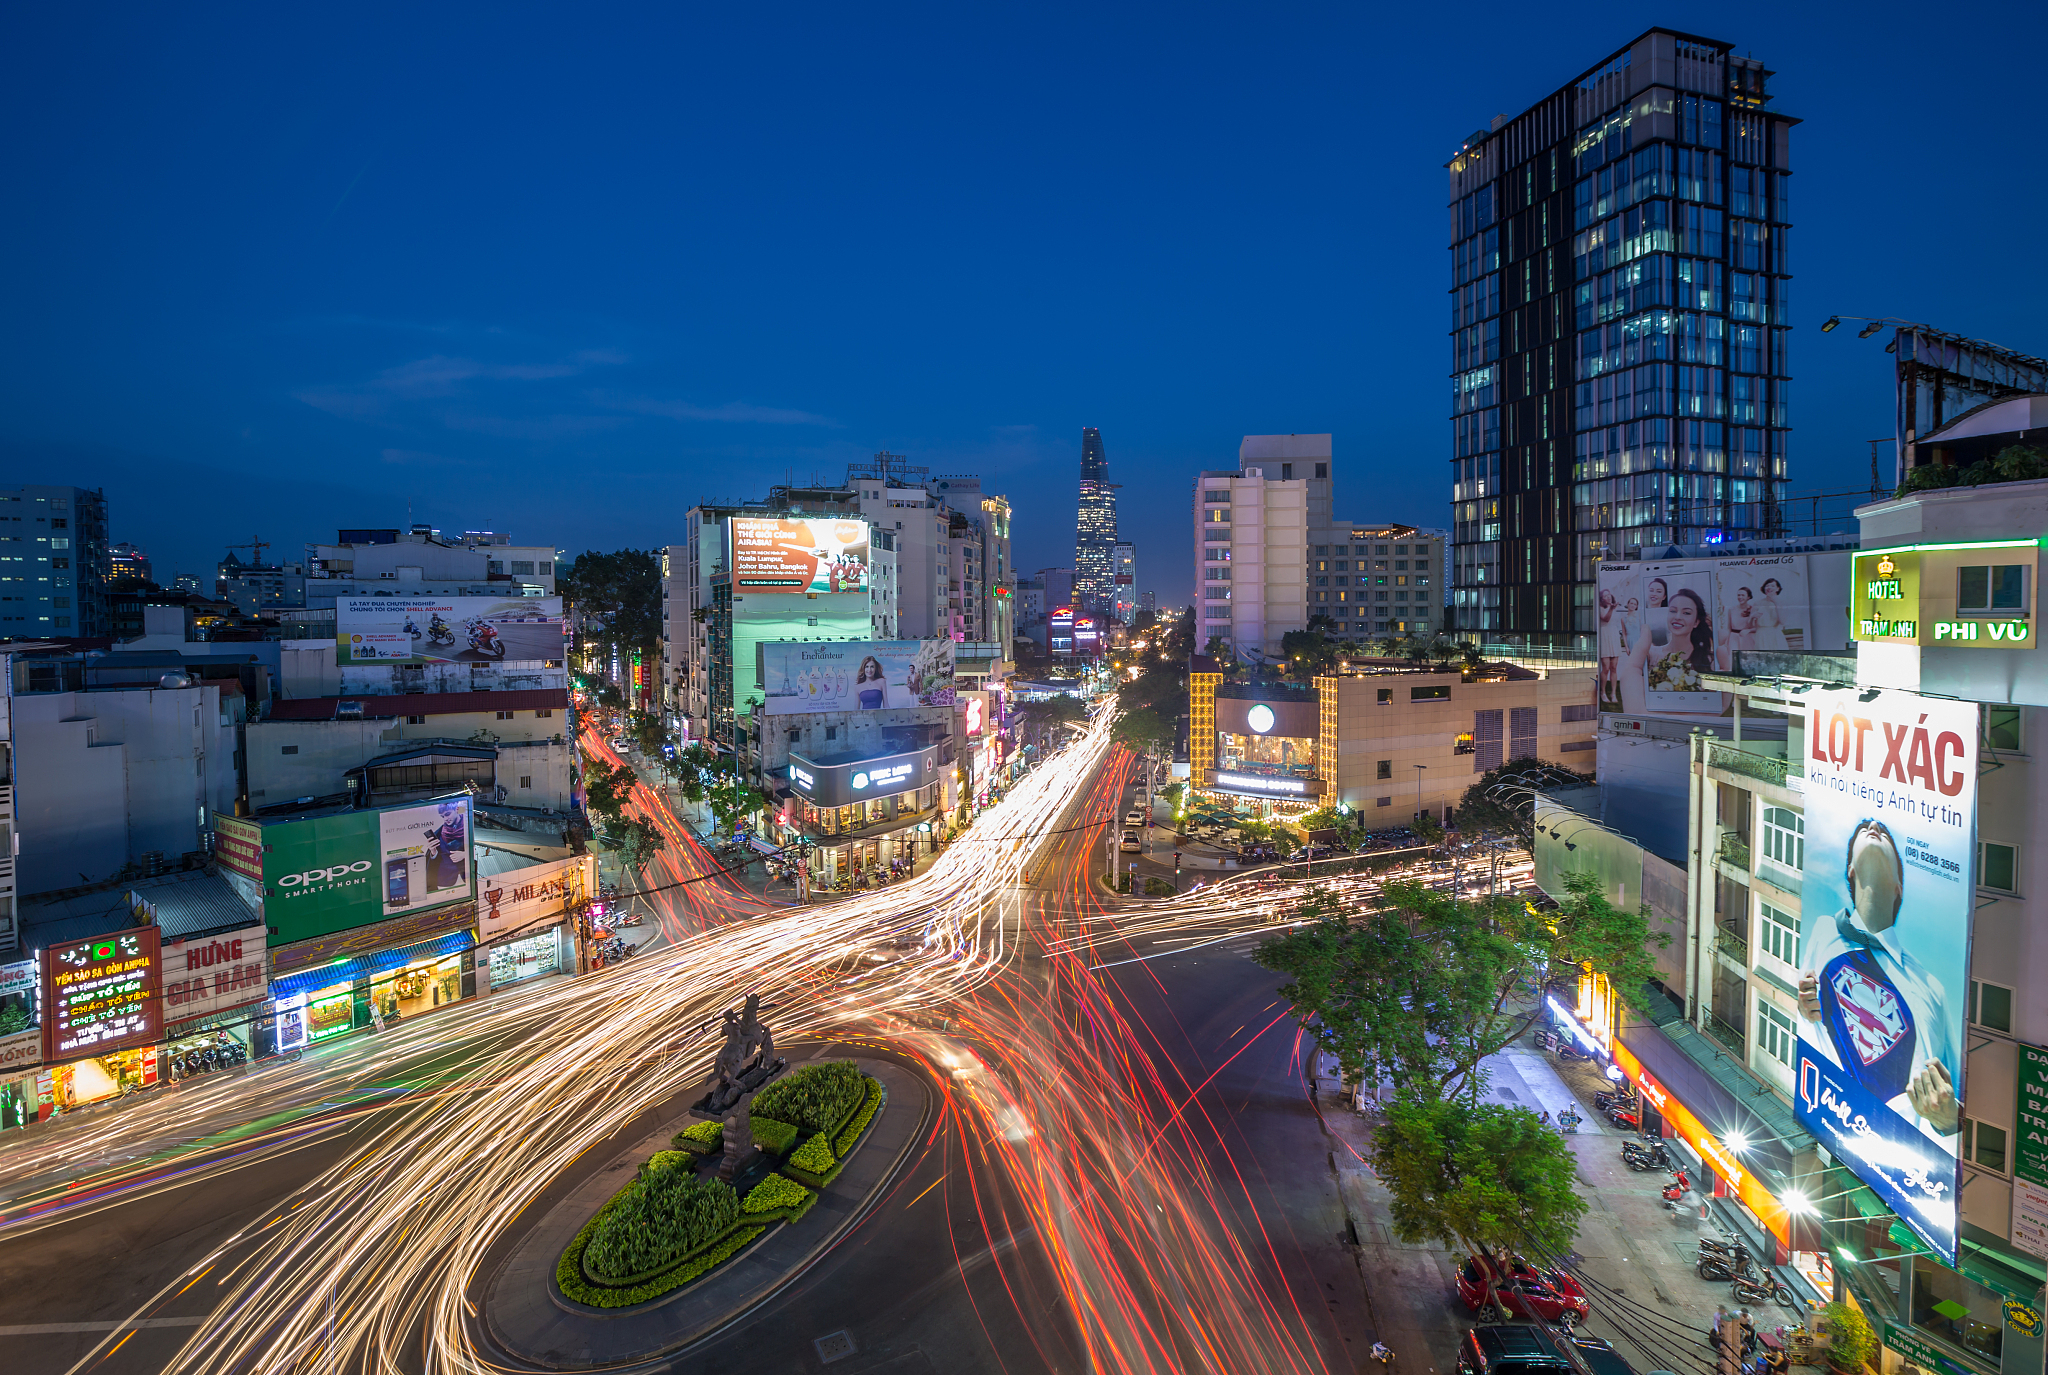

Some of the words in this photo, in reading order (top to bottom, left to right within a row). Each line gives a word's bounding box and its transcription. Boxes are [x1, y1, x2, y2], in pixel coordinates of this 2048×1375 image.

[737, 521, 761, 530] KHÁM
[762, 522, 779, 530] PHÁ
[774, 530, 796, 539] CÙNG
[1868, 580, 1902, 599] HOTEL
[1891, 622, 1914, 638] ANH
[1934, 622, 1977, 640] PHI
[1987, 619, 2028, 640] VŨ
[802, 650, 844, 660] Enchanteur
[1614, 721, 1632, 729] qmh
[1812, 702, 1874, 772] LỘT
[1879, 713, 1964, 796] XÁC
[1811, 766, 1826, 786] khi
[1830, 775, 1848, 794] nói
[1852, 780, 1884, 808] tiếng
[1888, 790, 1915, 814] Anh
[1921, 800, 1938, 822] tự
[1941, 805, 1962, 828] tin
[408, 845, 424, 856] 2K
[1907, 836, 1915, 845] GỌI
[1916, 840, 1929, 849] NGAY
[1905, 846, 1918, 860] (08)
[1921, 852, 1938, 865] 6288
[1941, 858, 1960, 873] 3566
[285, 886, 324, 899] SMART
[328, 878, 366, 890] PHONE
[55, 972, 73, 986] YẾN
[74, 969, 90, 981] SÀO
[106, 962, 122, 975] GÒN
[124, 957, 150, 970] ANPHA
[70, 992, 95, 1005] SÚP
[116, 981, 140, 993] YẾN
[168, 978, 208, 1006] GIA
[215, 964, 261, 994] HÂN
[70, 1002, 104, 1015] CHÁO
[1821, 1087, 1852, 1128] Wall
[2020, 1112, 2048, 1130] TR
[2022, 1214, 2039, 1225] EVA
[2024, 1234, 2040, 1245] THAI
[2025, 1308, 2040, 1321] ANH
[2008, 1321, 2034, 1337] COFFEE
[1916, 1351, 1935, 1366] ANH
